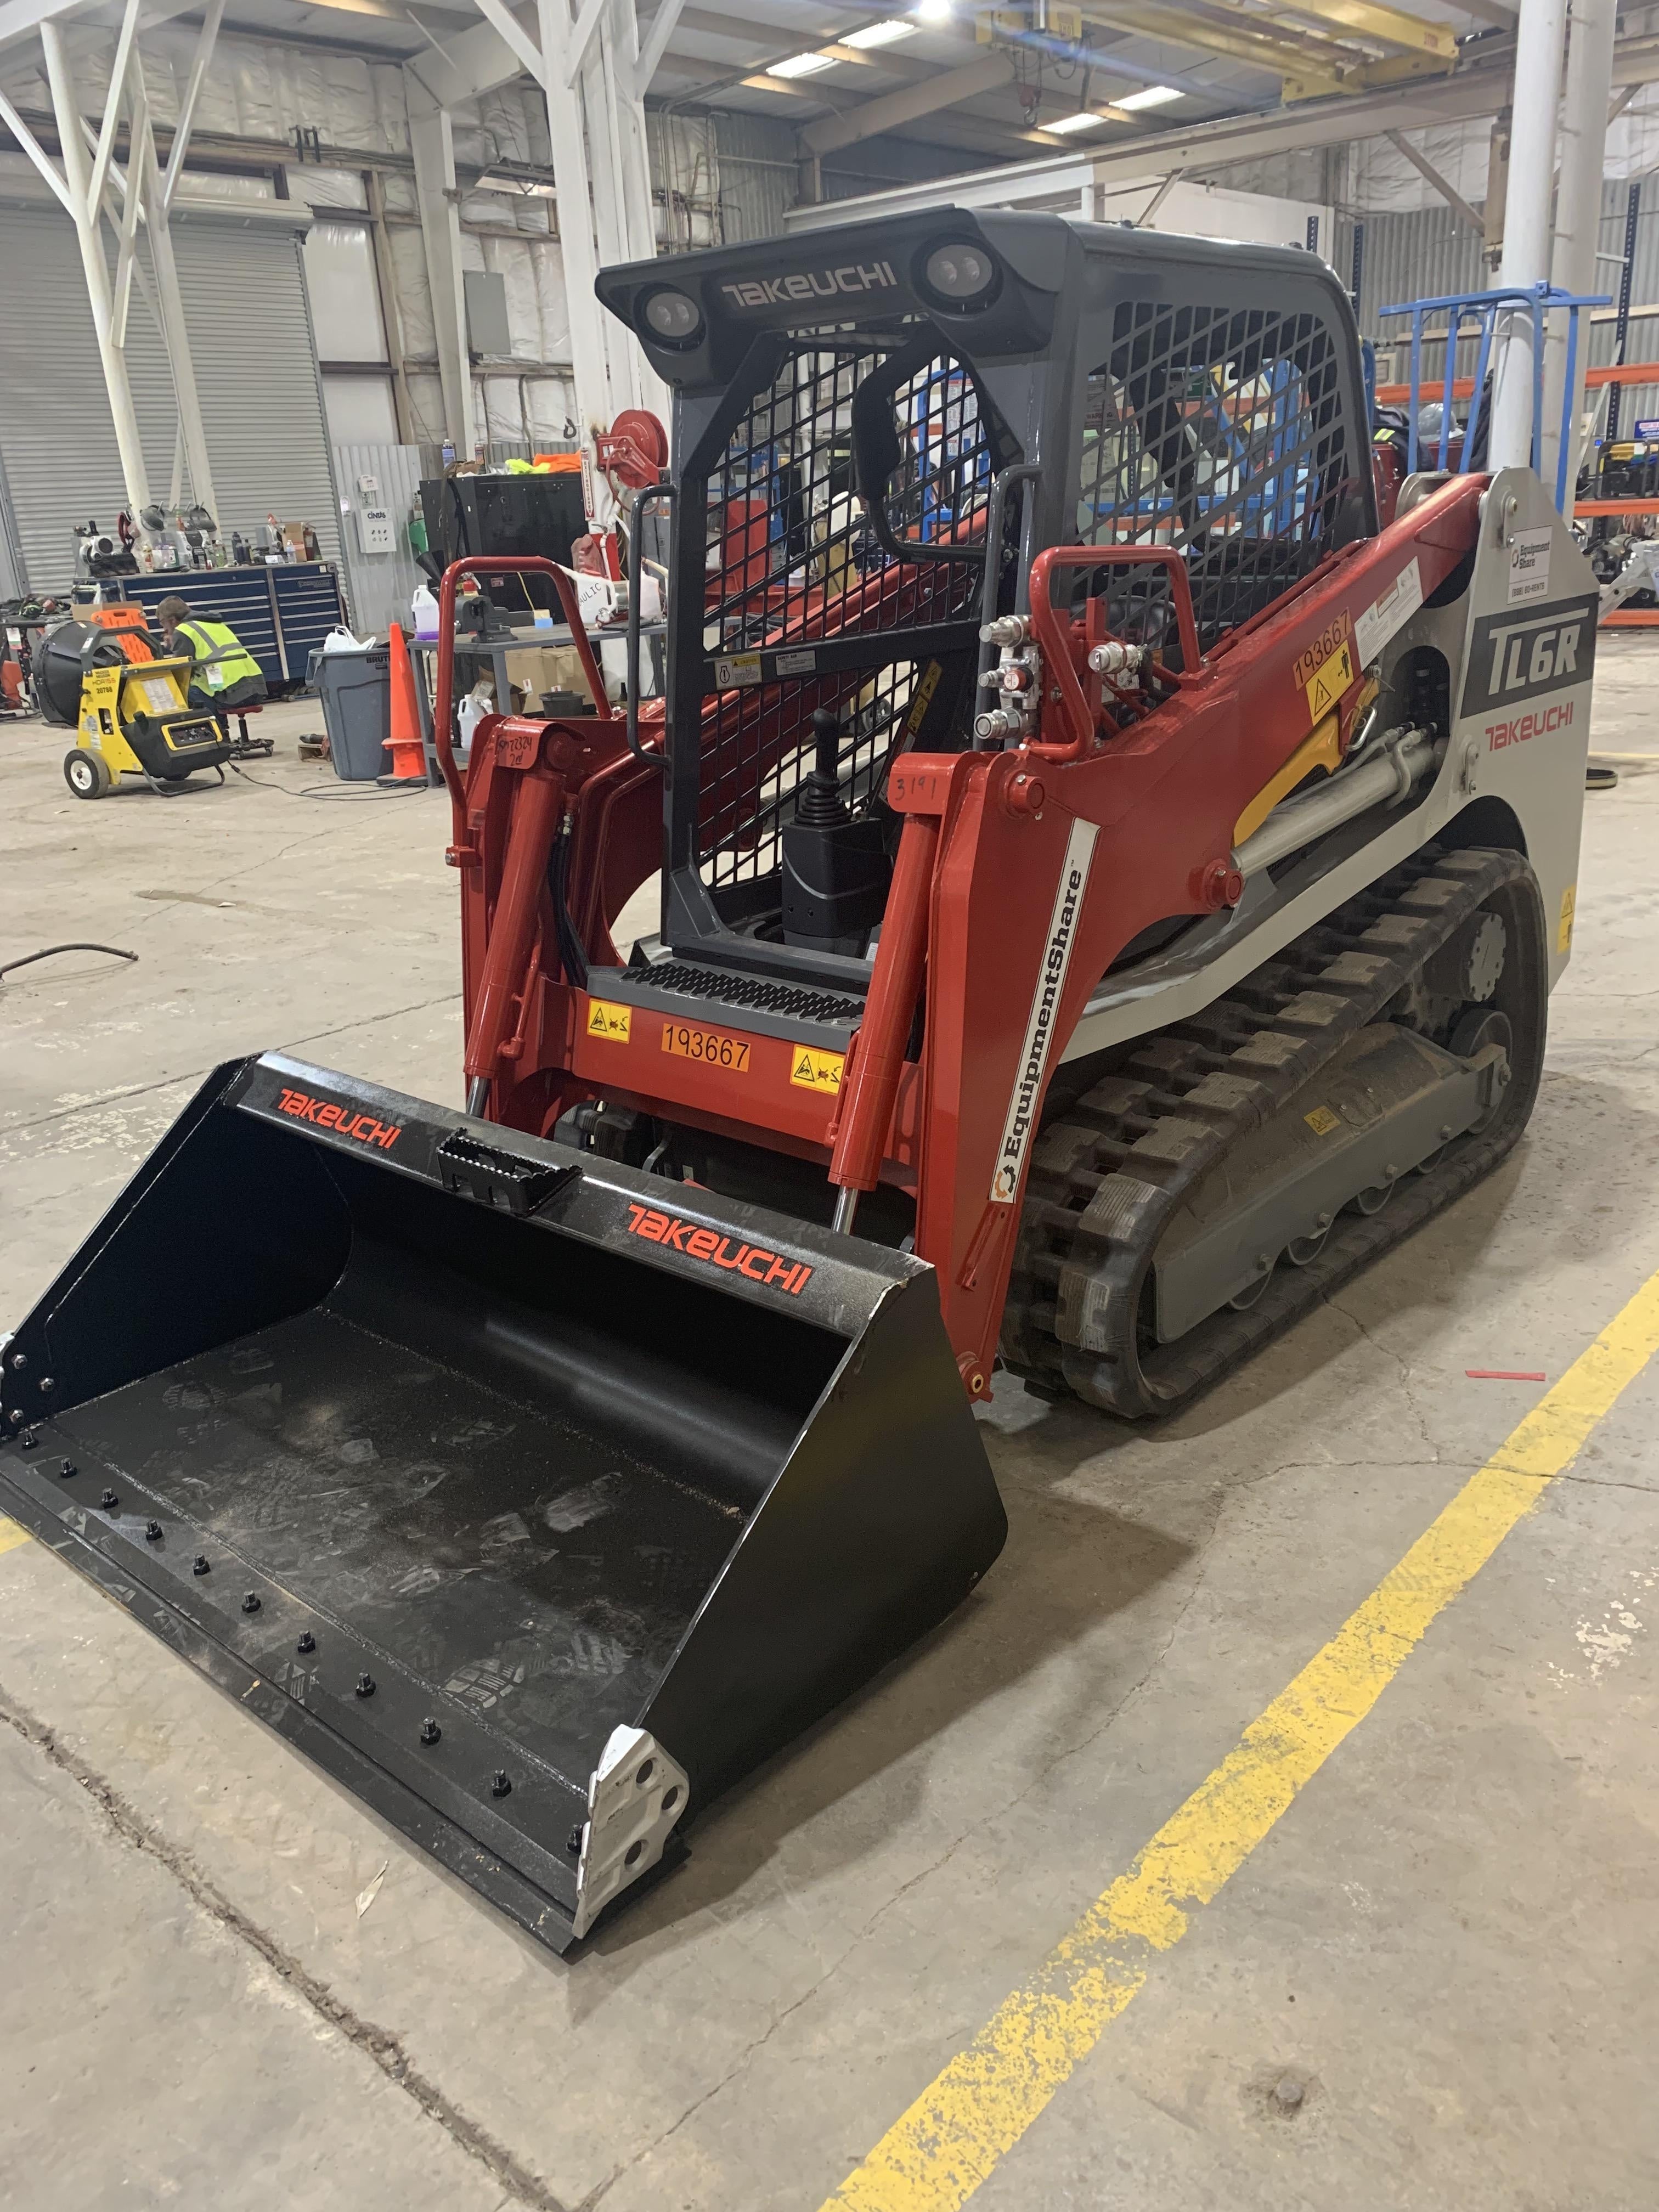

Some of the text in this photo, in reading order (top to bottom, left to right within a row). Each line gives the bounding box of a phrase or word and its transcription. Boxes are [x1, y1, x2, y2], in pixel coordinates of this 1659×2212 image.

[721, 261, 898, 307] TAKEUCHI
[584, 461, 592, 514] EXTINGUISHER
[368, 511, 386, 520] CINTAS
[1519, 557, 1536, 569] Share
[1520, 540, 1550, 558] Equipment
[1295, 609, 1348, 684] 193667
[1488, 607, 1589, 696] TL6R
[1485, 702, 1574, 752] TAKEUCHI
[665, 1025, 749, 1069] 193667
[278, 1088, 402, 1149] TAKEUCHI
[628, 1203, 814, 1295] TAKEUCHI
